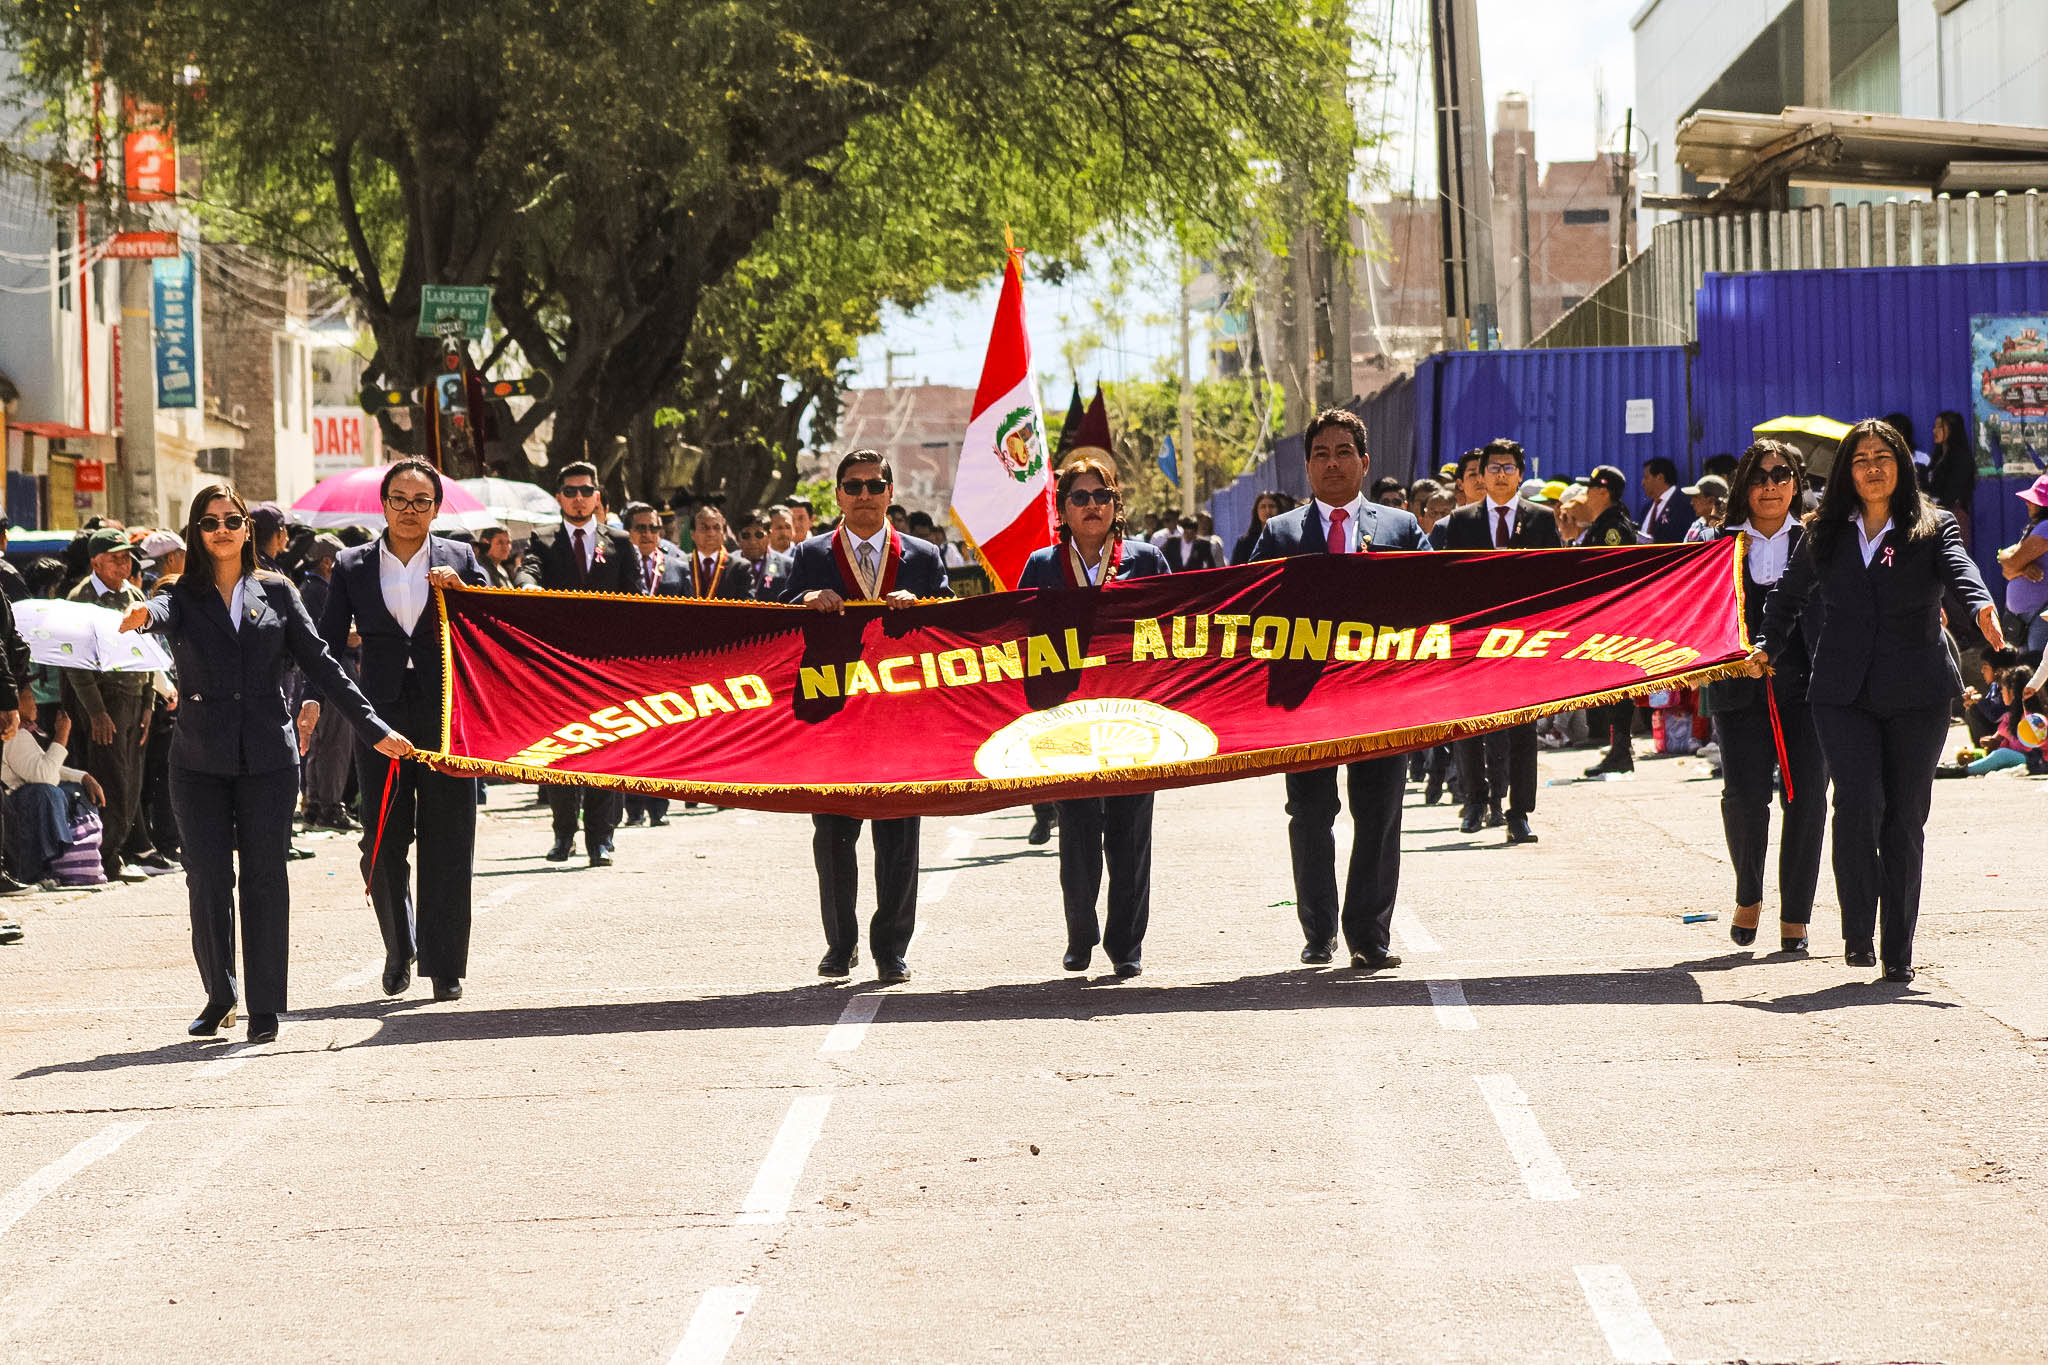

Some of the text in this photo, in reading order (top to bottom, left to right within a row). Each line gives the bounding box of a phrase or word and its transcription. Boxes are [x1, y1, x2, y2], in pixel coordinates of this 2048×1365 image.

[163, 289, 187, 372] DENTAL
[799, 627, 1107, 700] NACIONAL
[1132, 613, 1452, 662] AUTONOMA
[1475, 629, 1570, 658] DE
